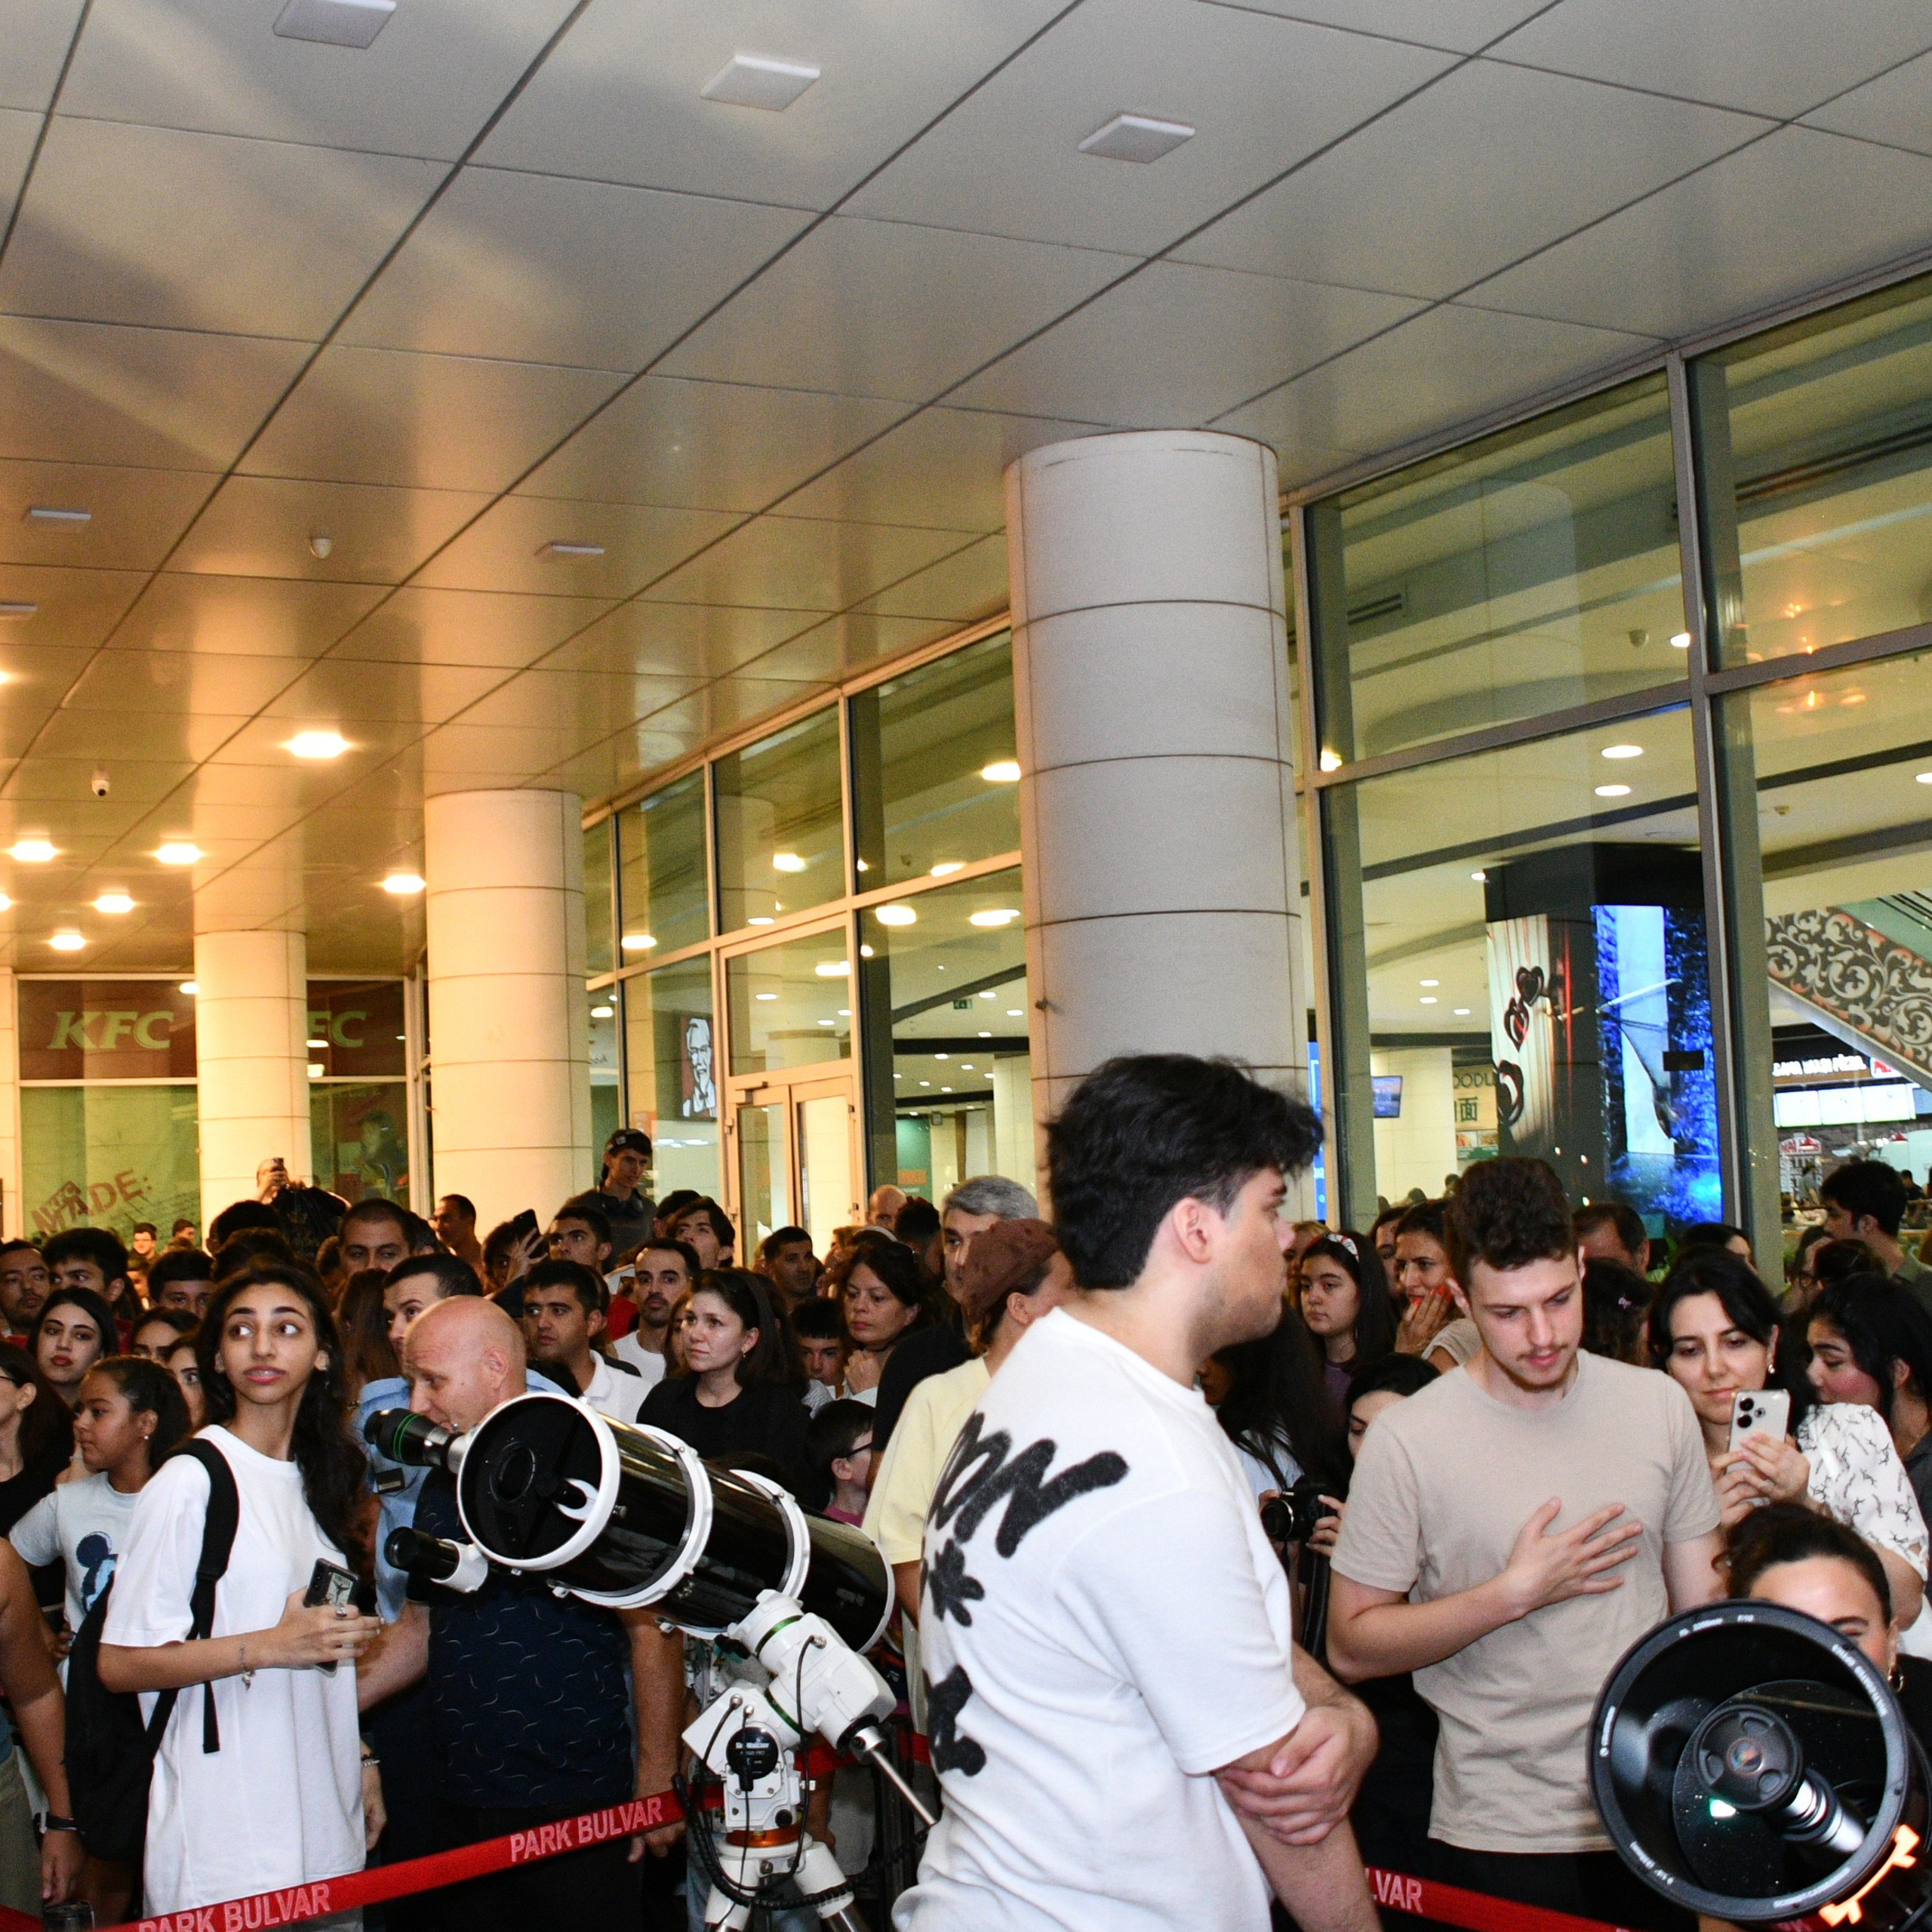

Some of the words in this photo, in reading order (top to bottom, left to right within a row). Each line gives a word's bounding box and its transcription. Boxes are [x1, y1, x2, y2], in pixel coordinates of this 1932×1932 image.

[46, 1011, 174, 1050] KFC
[510, 1820, 572, 1863] PARK
[577, 1796, 663, 1844] BULVAR
[223, 1883, 331, 1932] BULVAR
